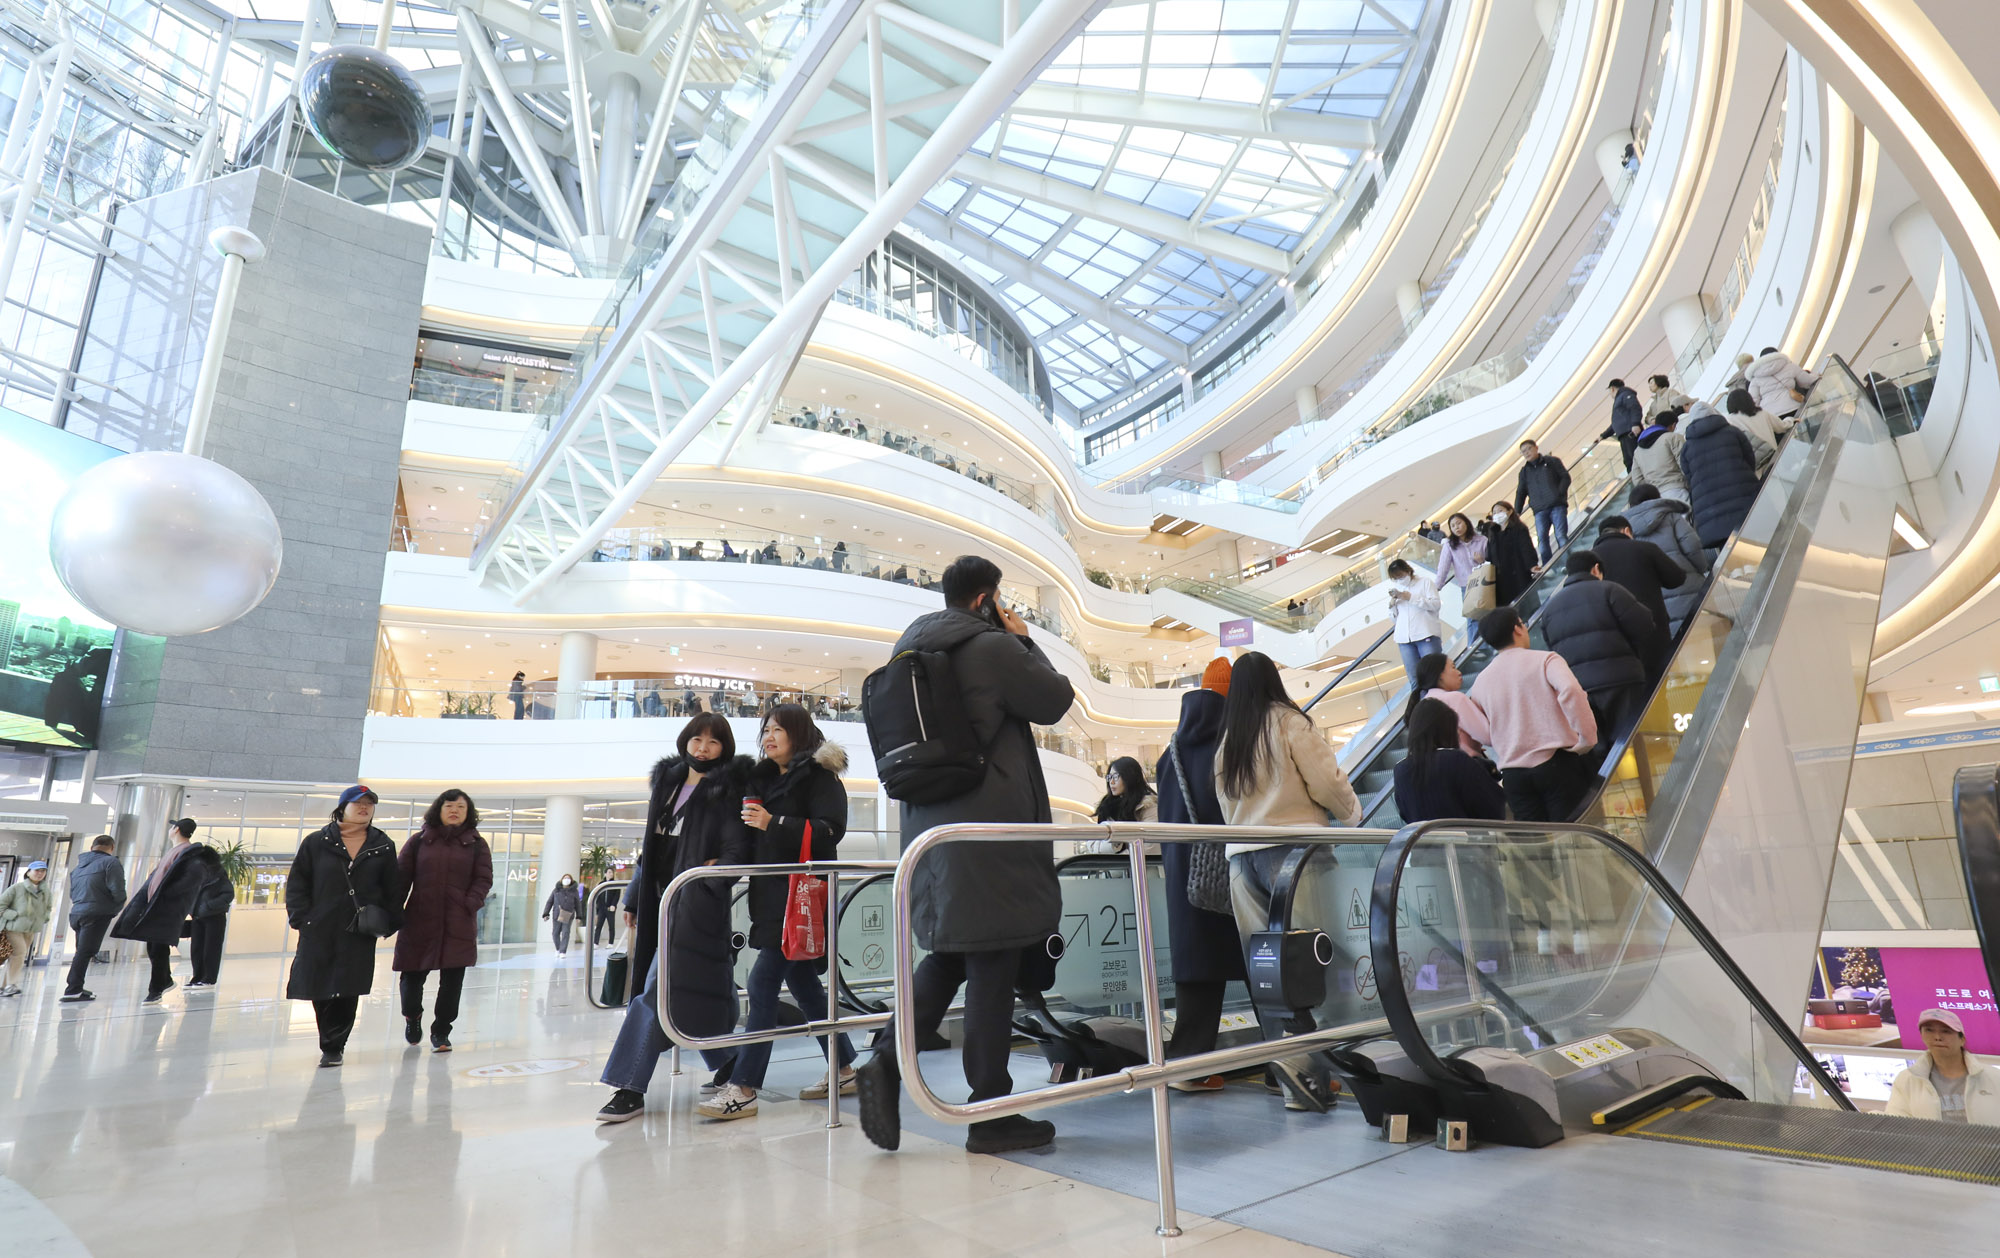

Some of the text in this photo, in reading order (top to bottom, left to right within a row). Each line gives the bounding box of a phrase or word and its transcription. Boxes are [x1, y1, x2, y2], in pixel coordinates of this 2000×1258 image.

[503, 354, 550, 369] AUGUSTIN
[1100, 905, 1137, 946] 2F
[1102, 960, 1127, 970] 교보문고
[1102, 980, 1127, 992] 무인양품
[1935, 988, 1994, 1000] 코드로 여
[1938, 1001, 1992, 1012] 네스프레소가
